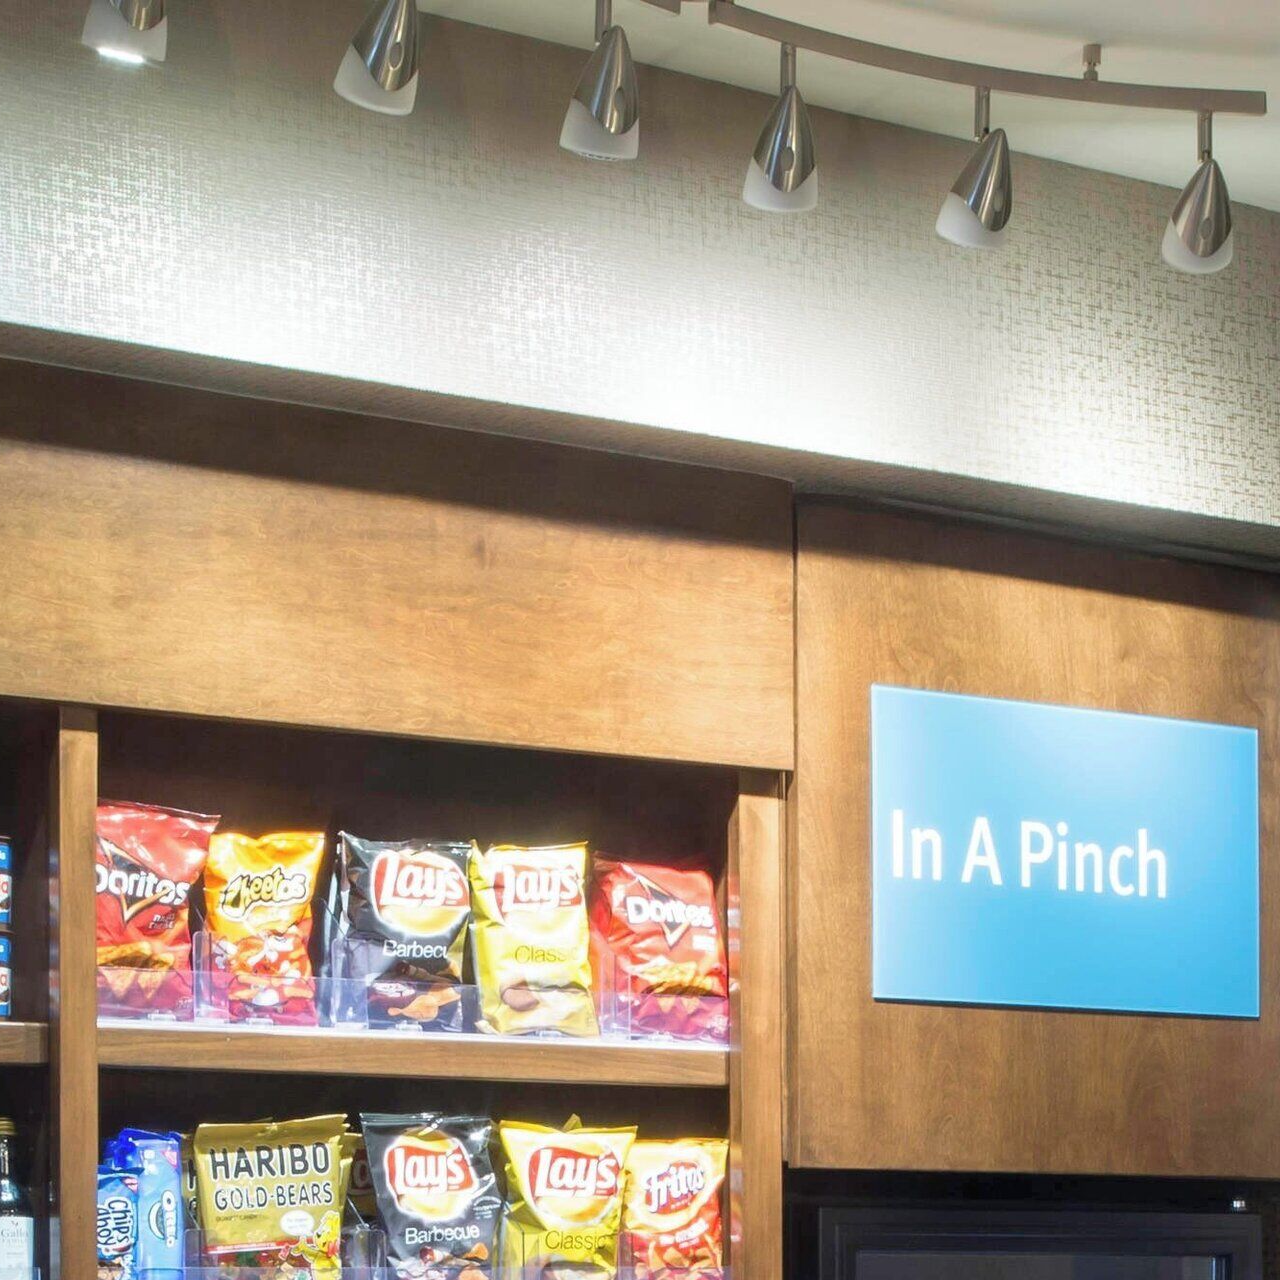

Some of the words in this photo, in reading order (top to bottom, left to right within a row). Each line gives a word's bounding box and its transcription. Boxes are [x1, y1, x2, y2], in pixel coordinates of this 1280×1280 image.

[892, 808, 943, 881] In
[961, 816, 1003, 886] A
[1020, 819, 1168, 899] Pinch
[382, 940, 448, 959] Barbecu
[209, 1142, 331, 1180] HARIBO
[214, 1182, 333, 1212] GOLD-BEARS
[405, 1223, 480, 1245] Barbecue
[544, 1229, 607, 1251] Classic
